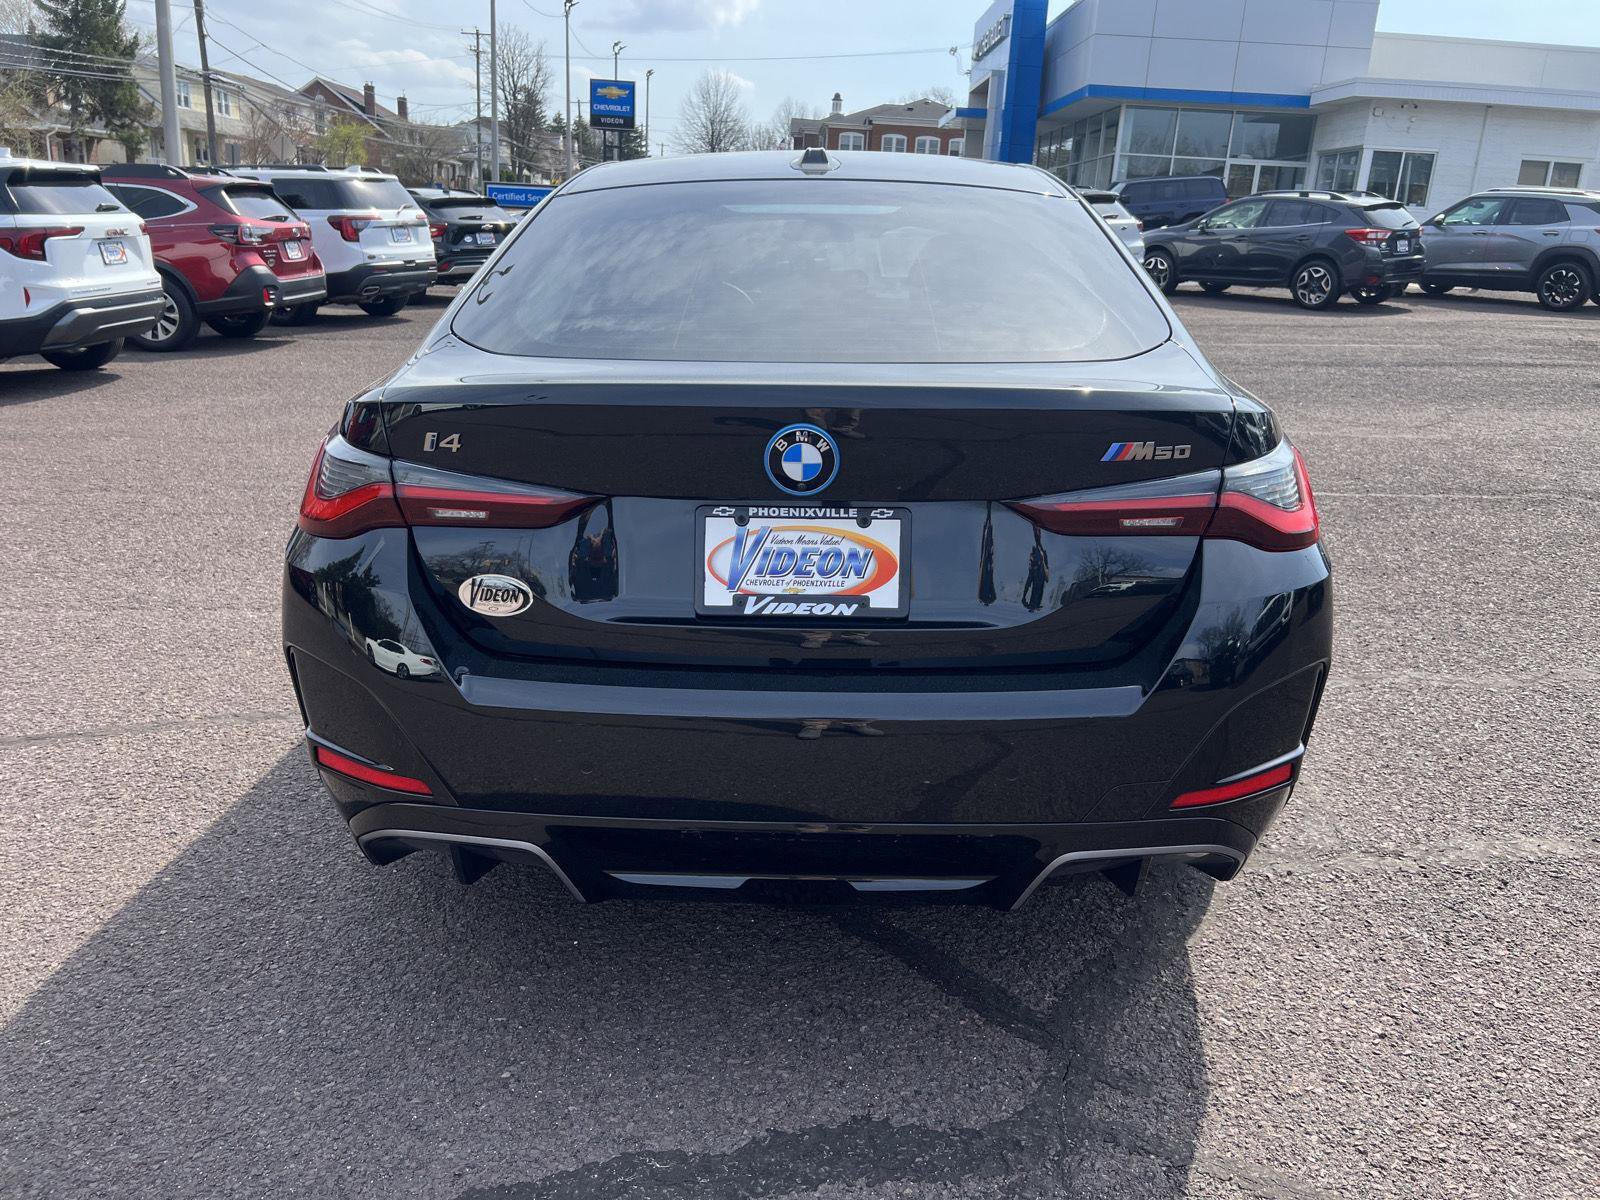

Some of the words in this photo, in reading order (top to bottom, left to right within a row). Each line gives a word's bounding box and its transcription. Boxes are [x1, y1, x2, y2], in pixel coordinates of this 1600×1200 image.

[593, 103, 630, 112] CHEVROLET
[491, 192, 525, 201] Certified
[423, 432, 462, 453] i4
[775, 430, 830, 452] BMW
[748, 507, 858, 518] PHOENIXVILLE
[770, 534, 793, 545] Videon
[795, 534, 818, 545] Means
[820, 535, 846, 546] Value!
[727, 526, 874, 592] VIDEON
[785, 579, 792, 587] of
[469, 578, 521, 607] VIDEON
[743, 596, 859, 616] VIDEON
